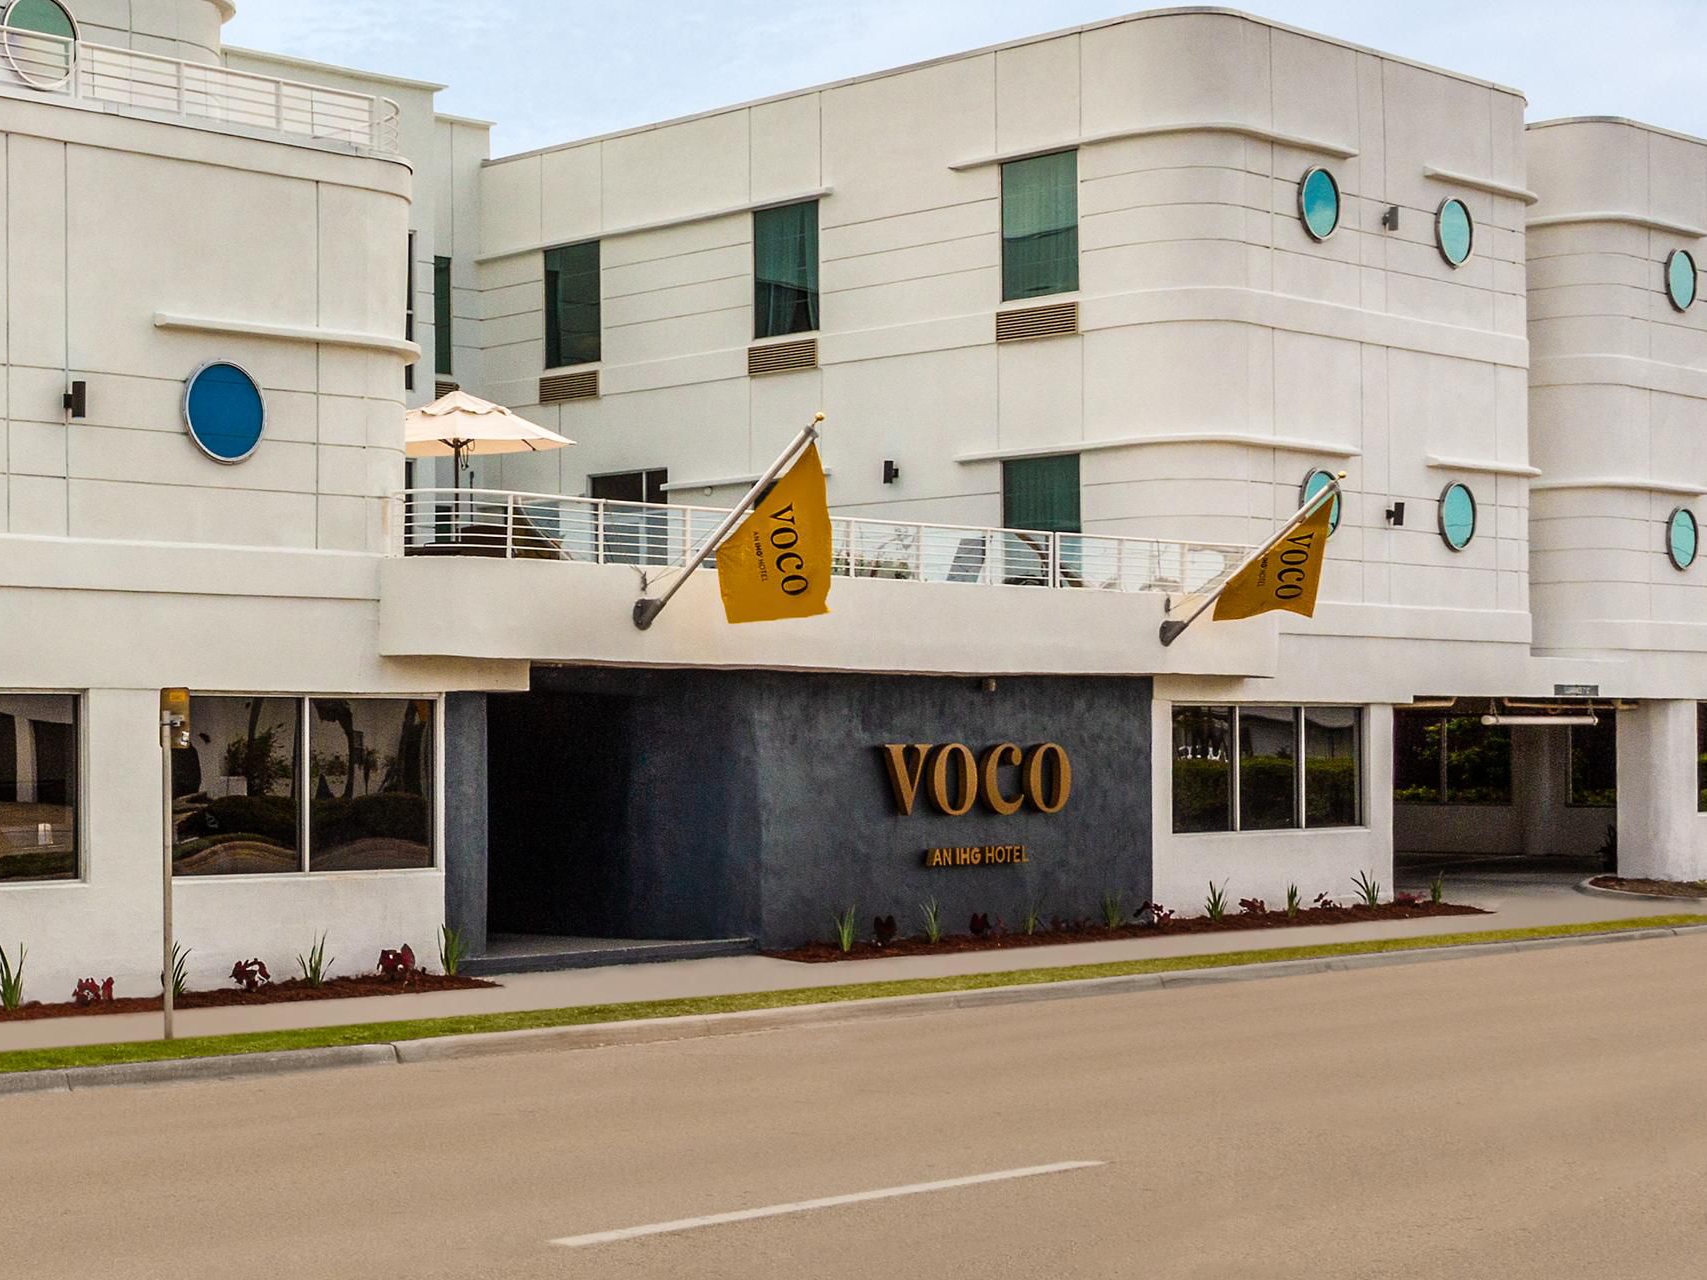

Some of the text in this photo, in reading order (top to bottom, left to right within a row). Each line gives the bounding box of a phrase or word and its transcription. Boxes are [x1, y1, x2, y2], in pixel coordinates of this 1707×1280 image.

[758, 558, 768, 582] HOTEL
[769, 502, 809, 596] VOCO
[1275, 532, 1314, 600] VOCO
[883, 742, 1072, 816] VOCO
[931, 845, 1029, 866] AN IHG HOTEL
